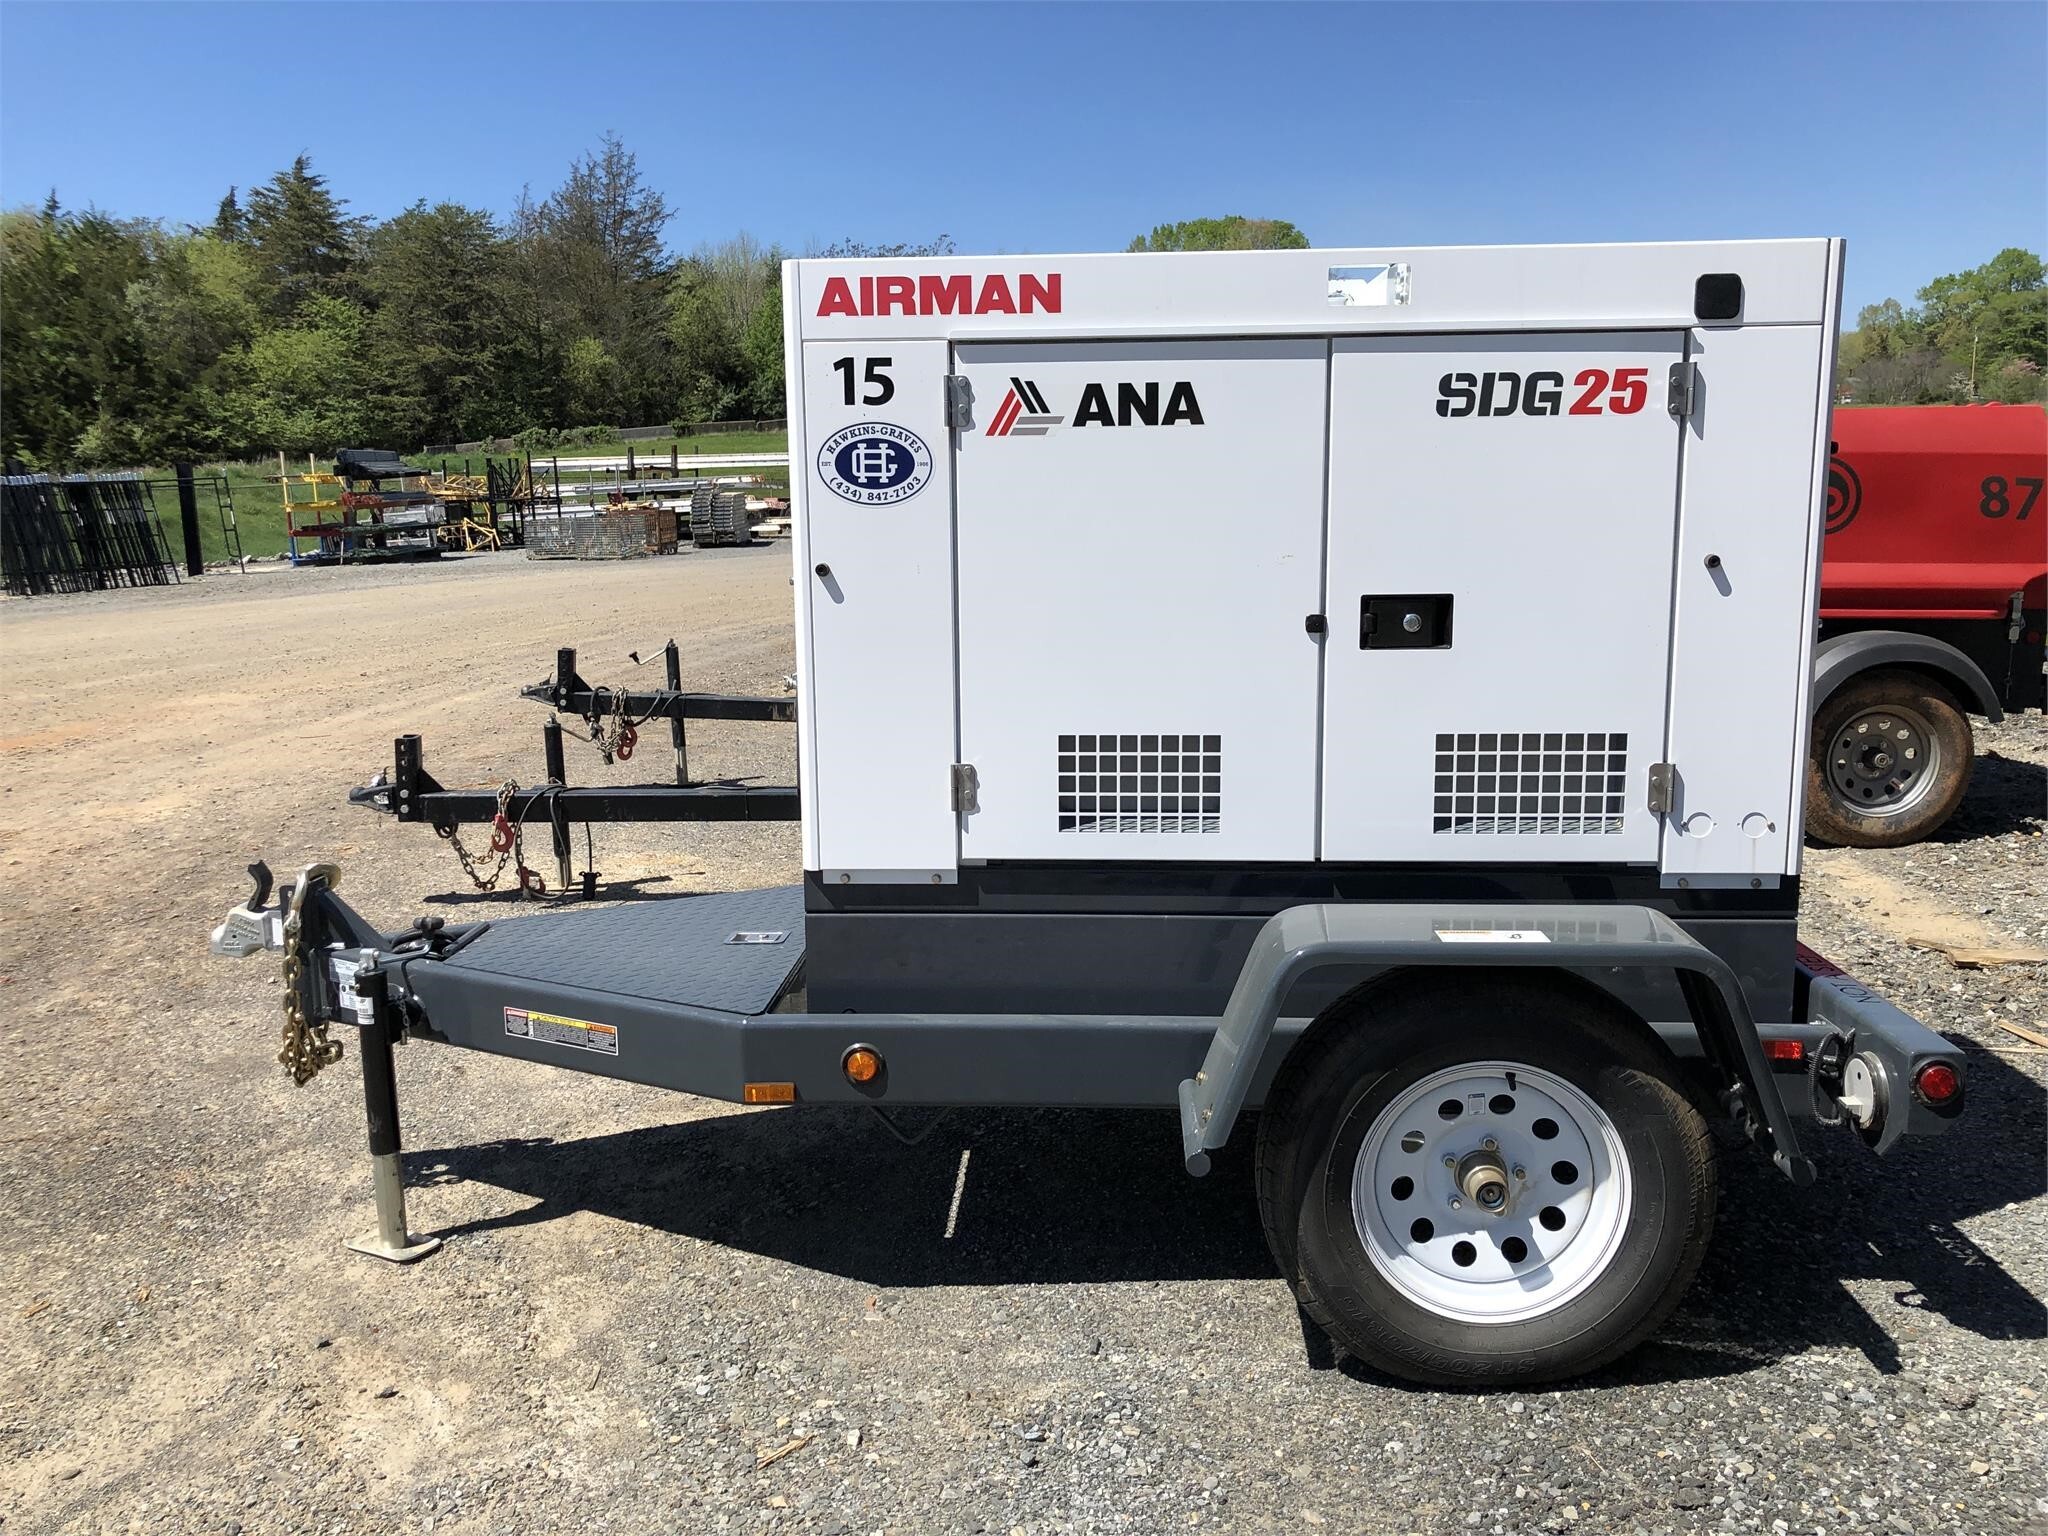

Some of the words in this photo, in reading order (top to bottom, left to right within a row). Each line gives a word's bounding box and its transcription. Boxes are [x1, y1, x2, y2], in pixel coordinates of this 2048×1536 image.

[816, 273, 1062, 317] AIRMAN
[832, 356, 895, 406] 15
[1072, 381, 1205, 427] ANA
[826, 425, 922, 455] HAWKINS-GRAVES
[829, 477, 862, 501] (434)
[867, 476, 921, 501] 847-7703
[1979, 475, 2044, 521] 87
